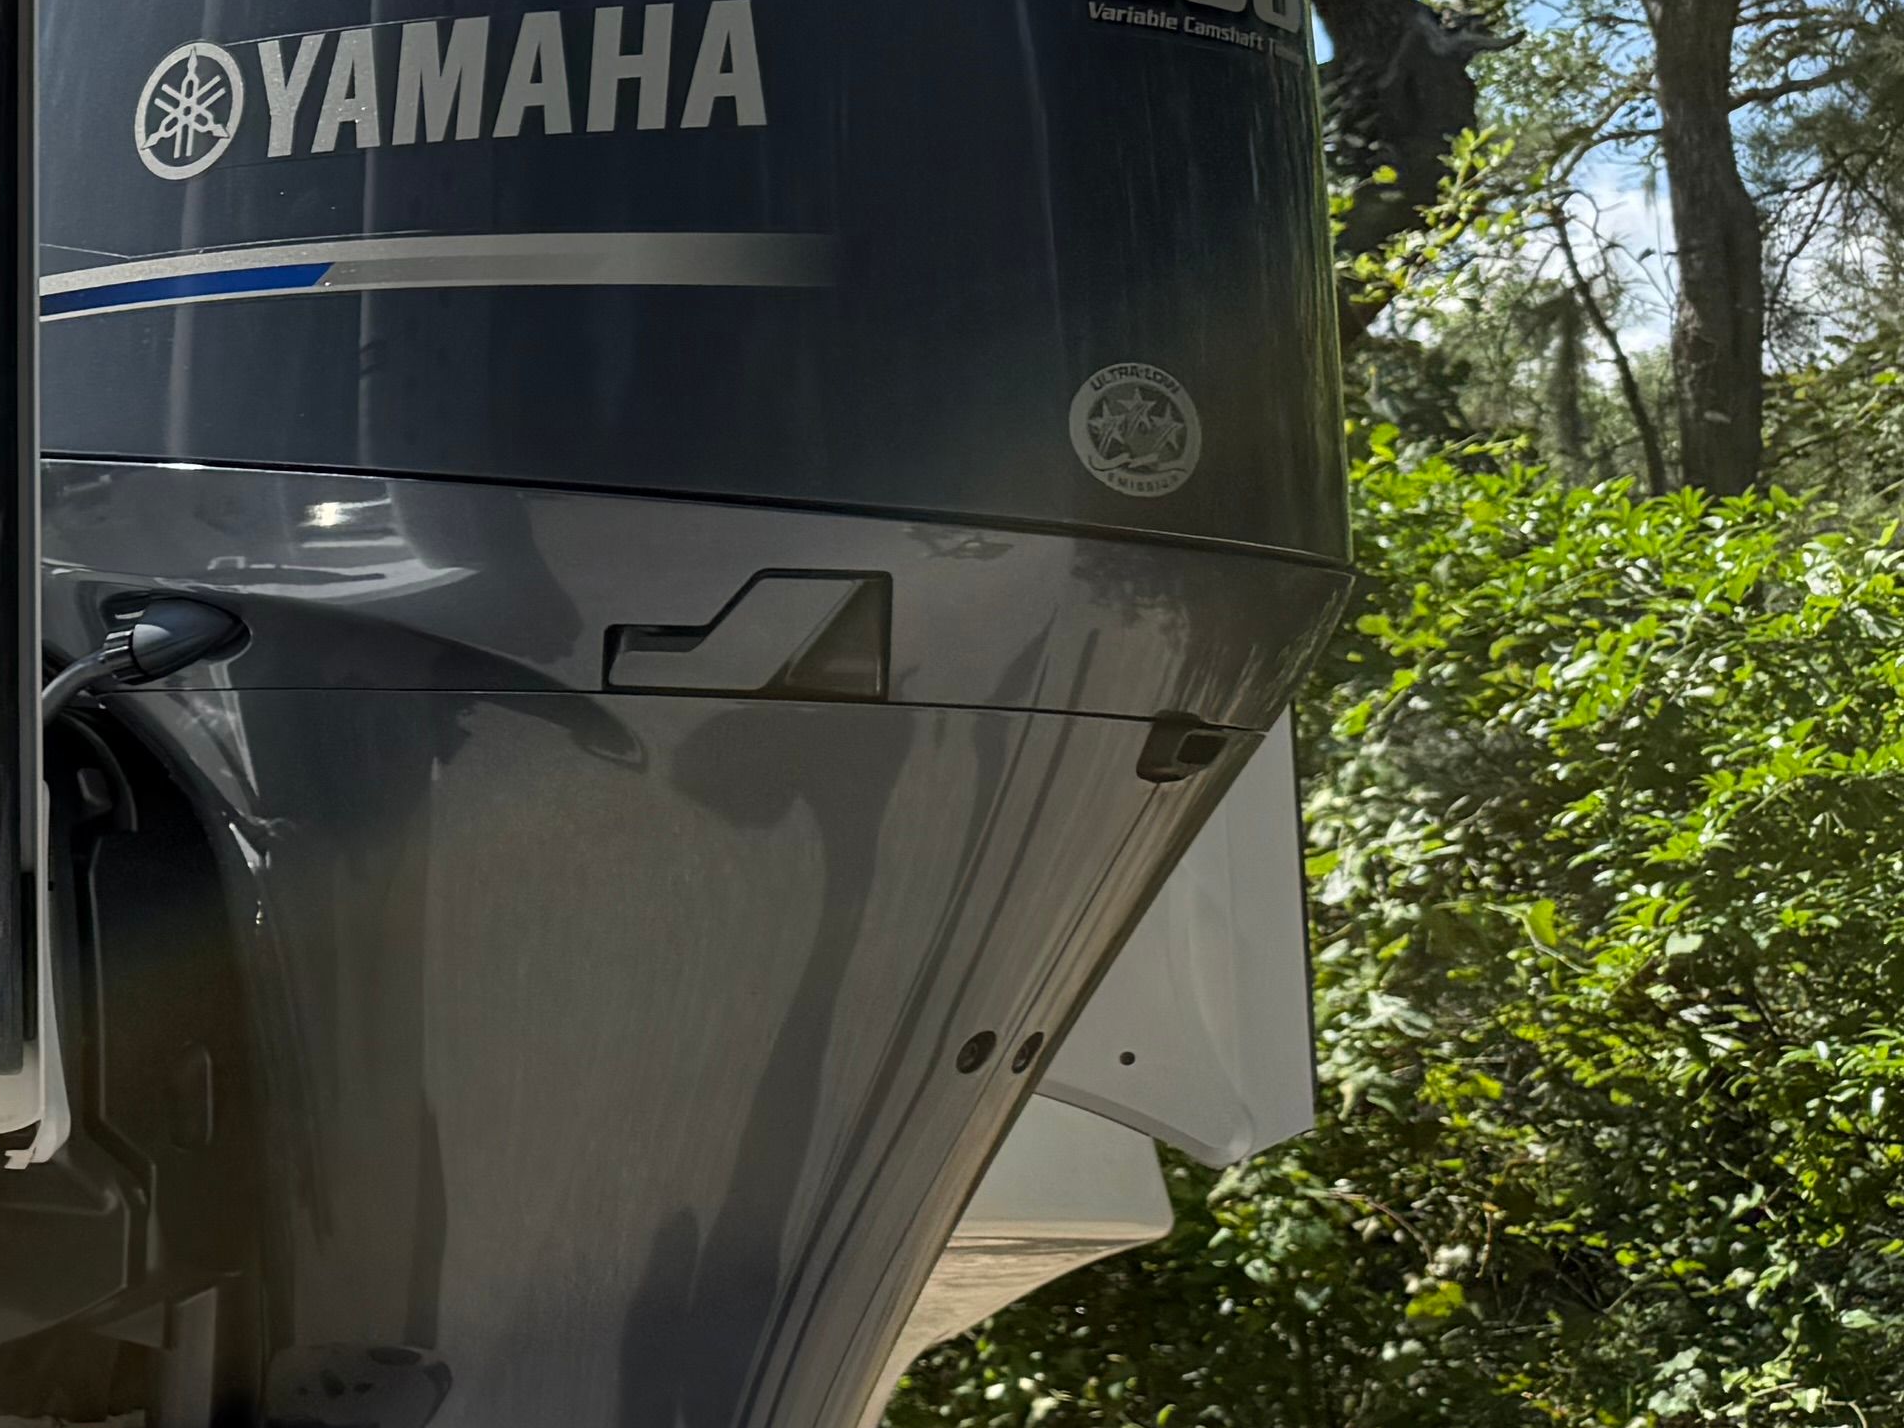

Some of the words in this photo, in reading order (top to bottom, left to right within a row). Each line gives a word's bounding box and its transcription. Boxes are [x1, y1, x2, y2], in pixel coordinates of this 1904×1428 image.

[1088, 1, 1179, 30] Variable
[1183, 16, 1264, 48] Camshaft
[258, 0, 767, 157] YAMAHA
